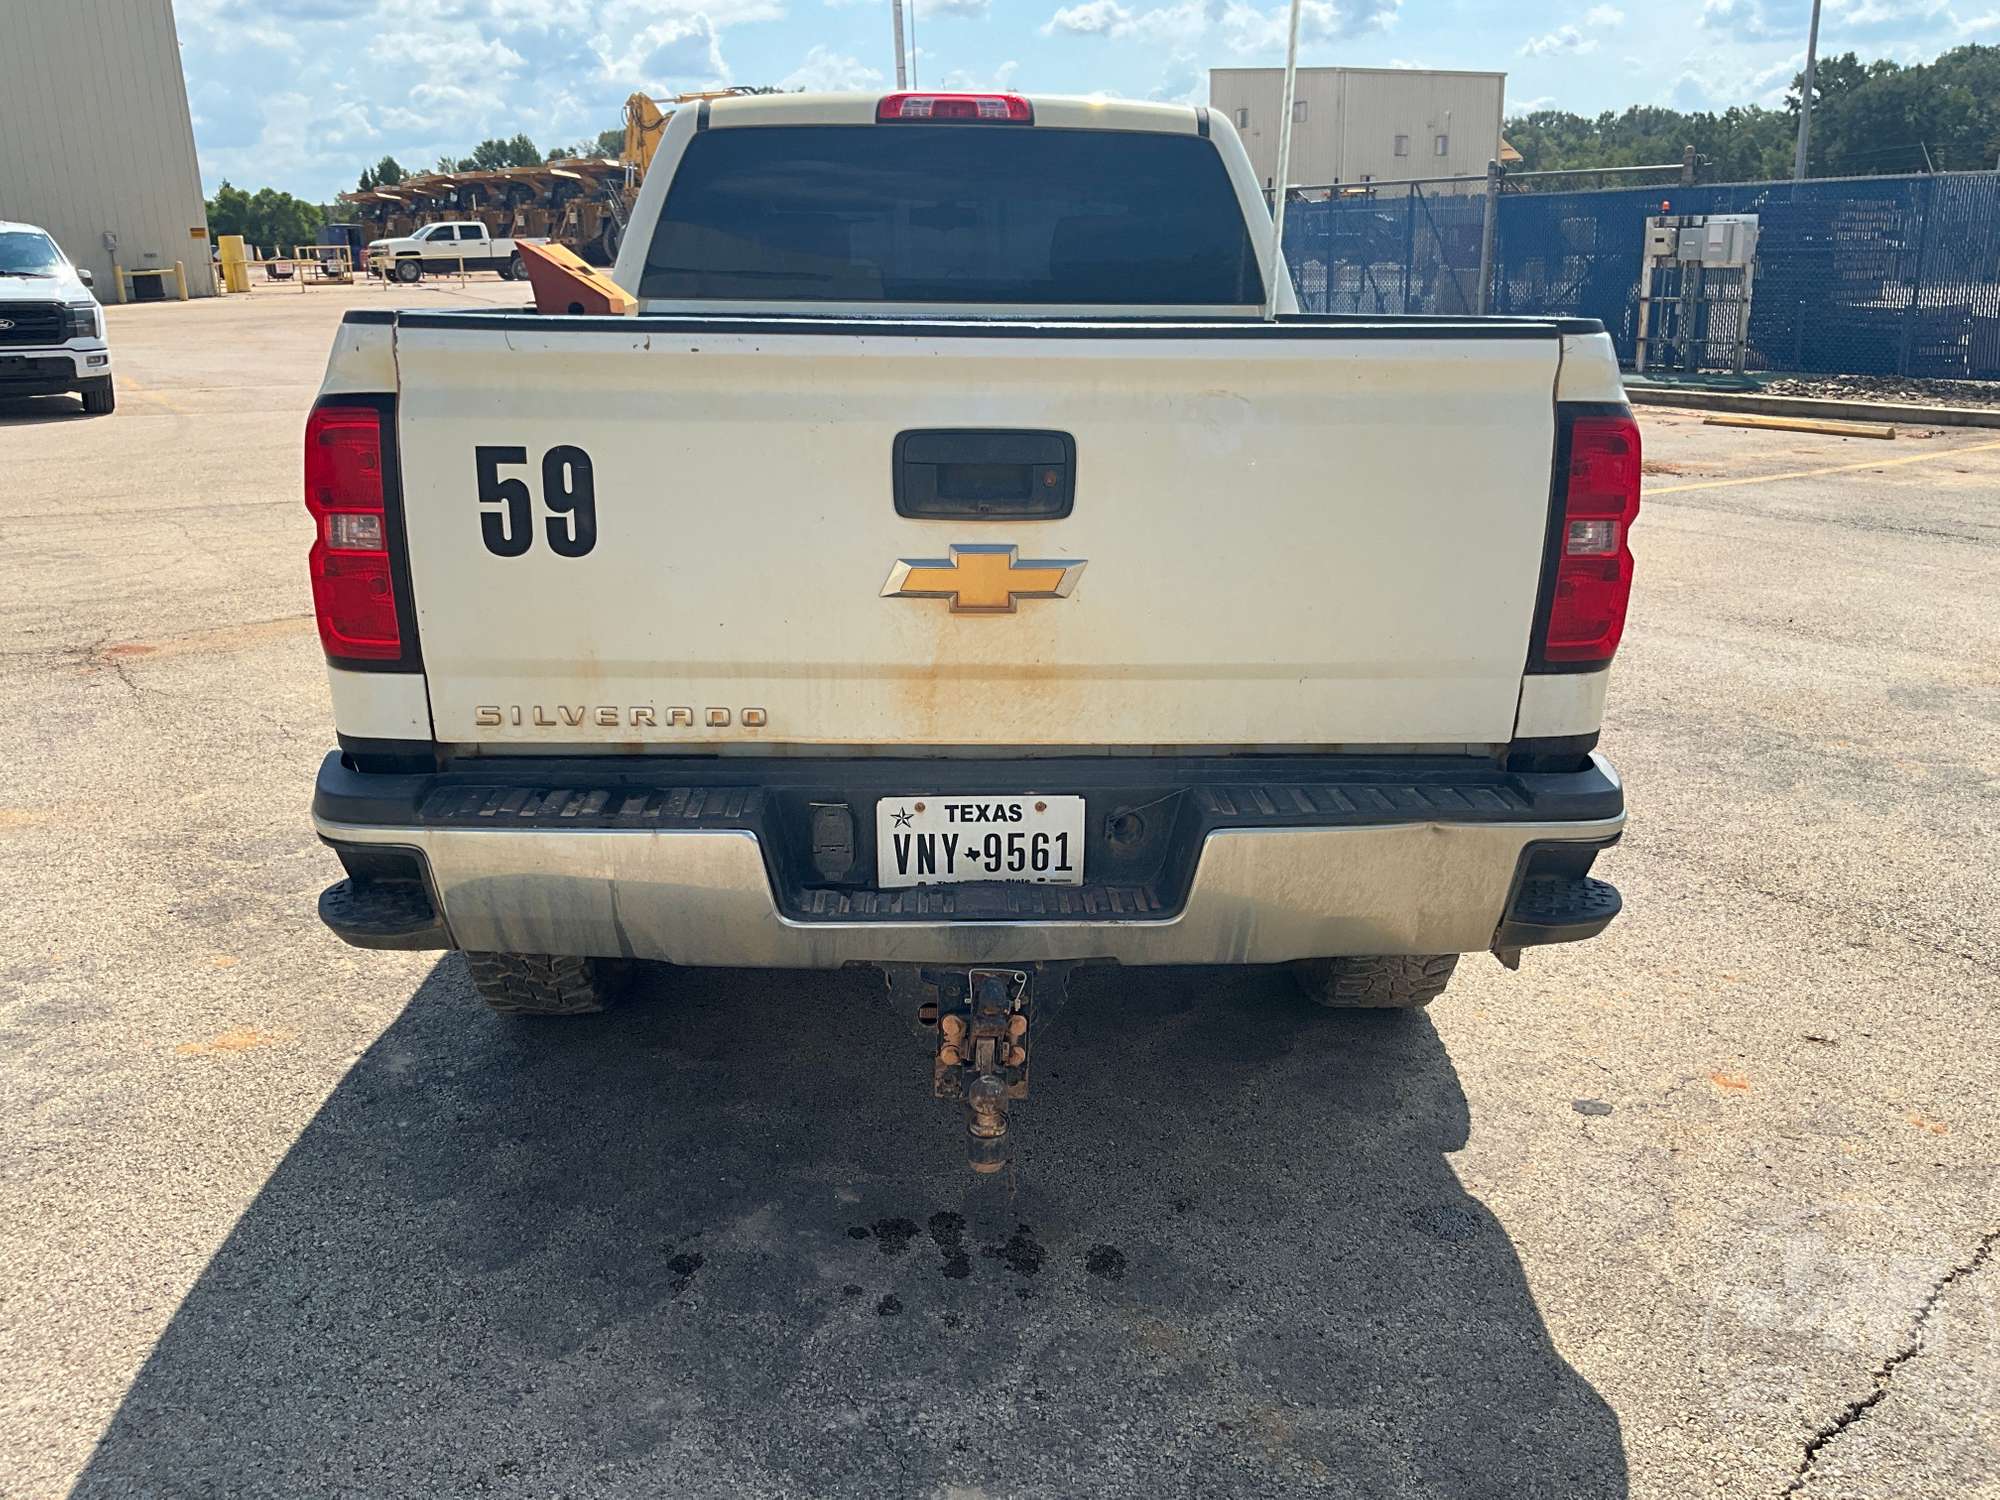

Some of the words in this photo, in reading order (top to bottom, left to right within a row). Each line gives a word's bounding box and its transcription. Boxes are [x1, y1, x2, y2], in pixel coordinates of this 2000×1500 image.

[475, 445, 597, 557] 59
[475, 705, 767, 727] SILVERADO
[944, 804, 1023, 823] TEXAS
[893, 833, 960, 875] VNY
[983, 831, 1073, 873] 9561
